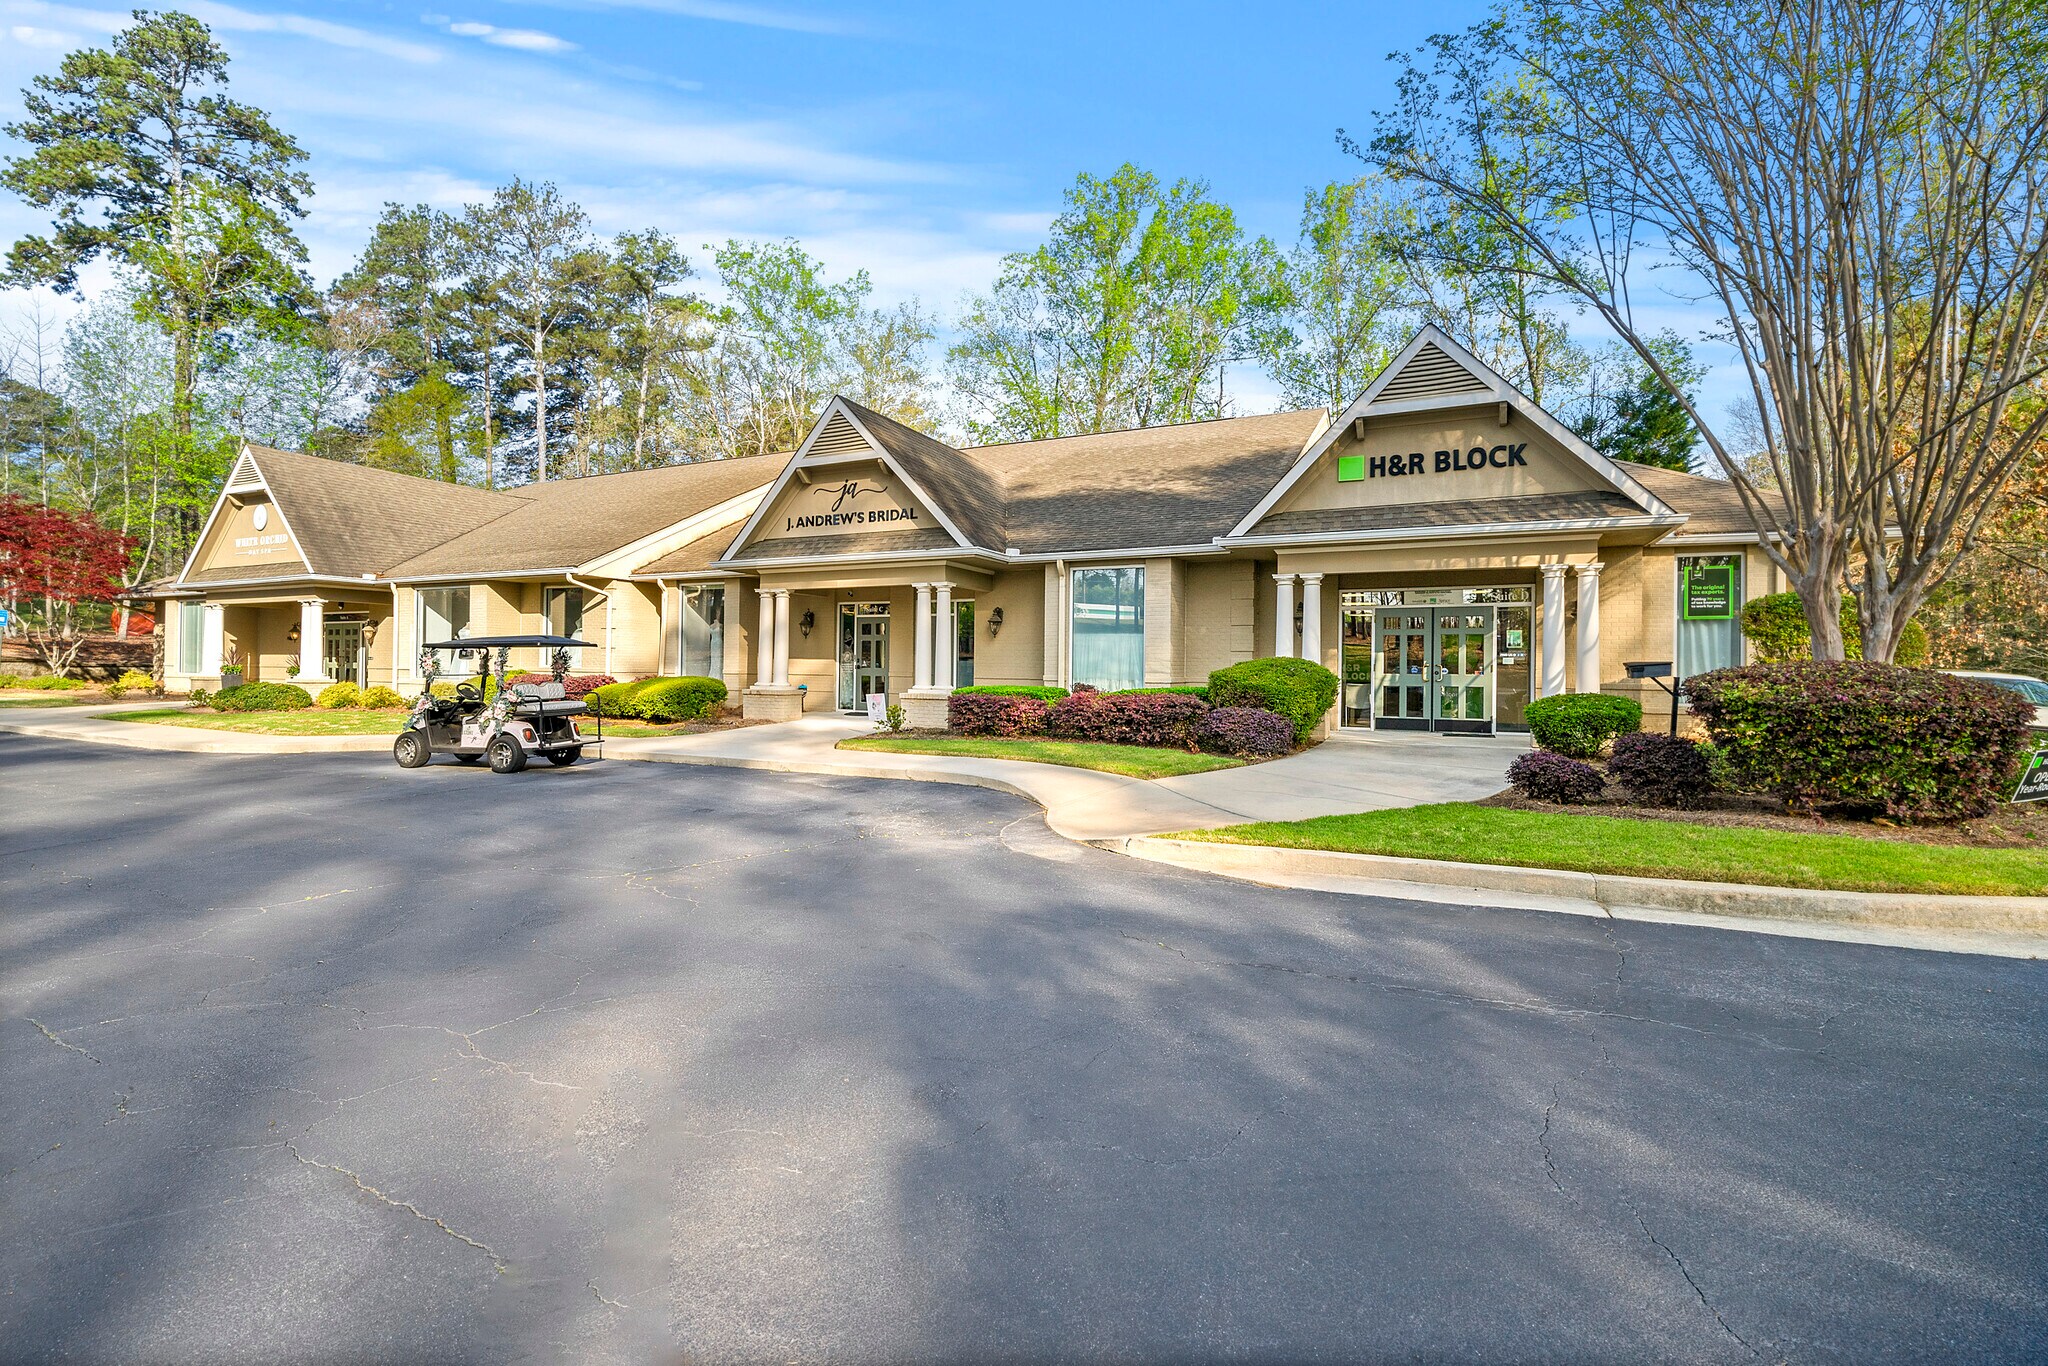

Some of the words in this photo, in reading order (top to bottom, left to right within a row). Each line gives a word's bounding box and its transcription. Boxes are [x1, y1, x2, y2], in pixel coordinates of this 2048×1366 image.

[1370, 453, 1425, 478] H&R
[1434, 443, 1528, 473] BLOCK
[786, 517, 795, 532] J.
[795, 511, 865, 529] ANDREW'S
[868, 507, 918, 523] BRIDAL
[235, 537, 258, 548] WHITE
[260, 534, 288, 546] ORCHID
[1492, 590, 1518, 602] Suite
